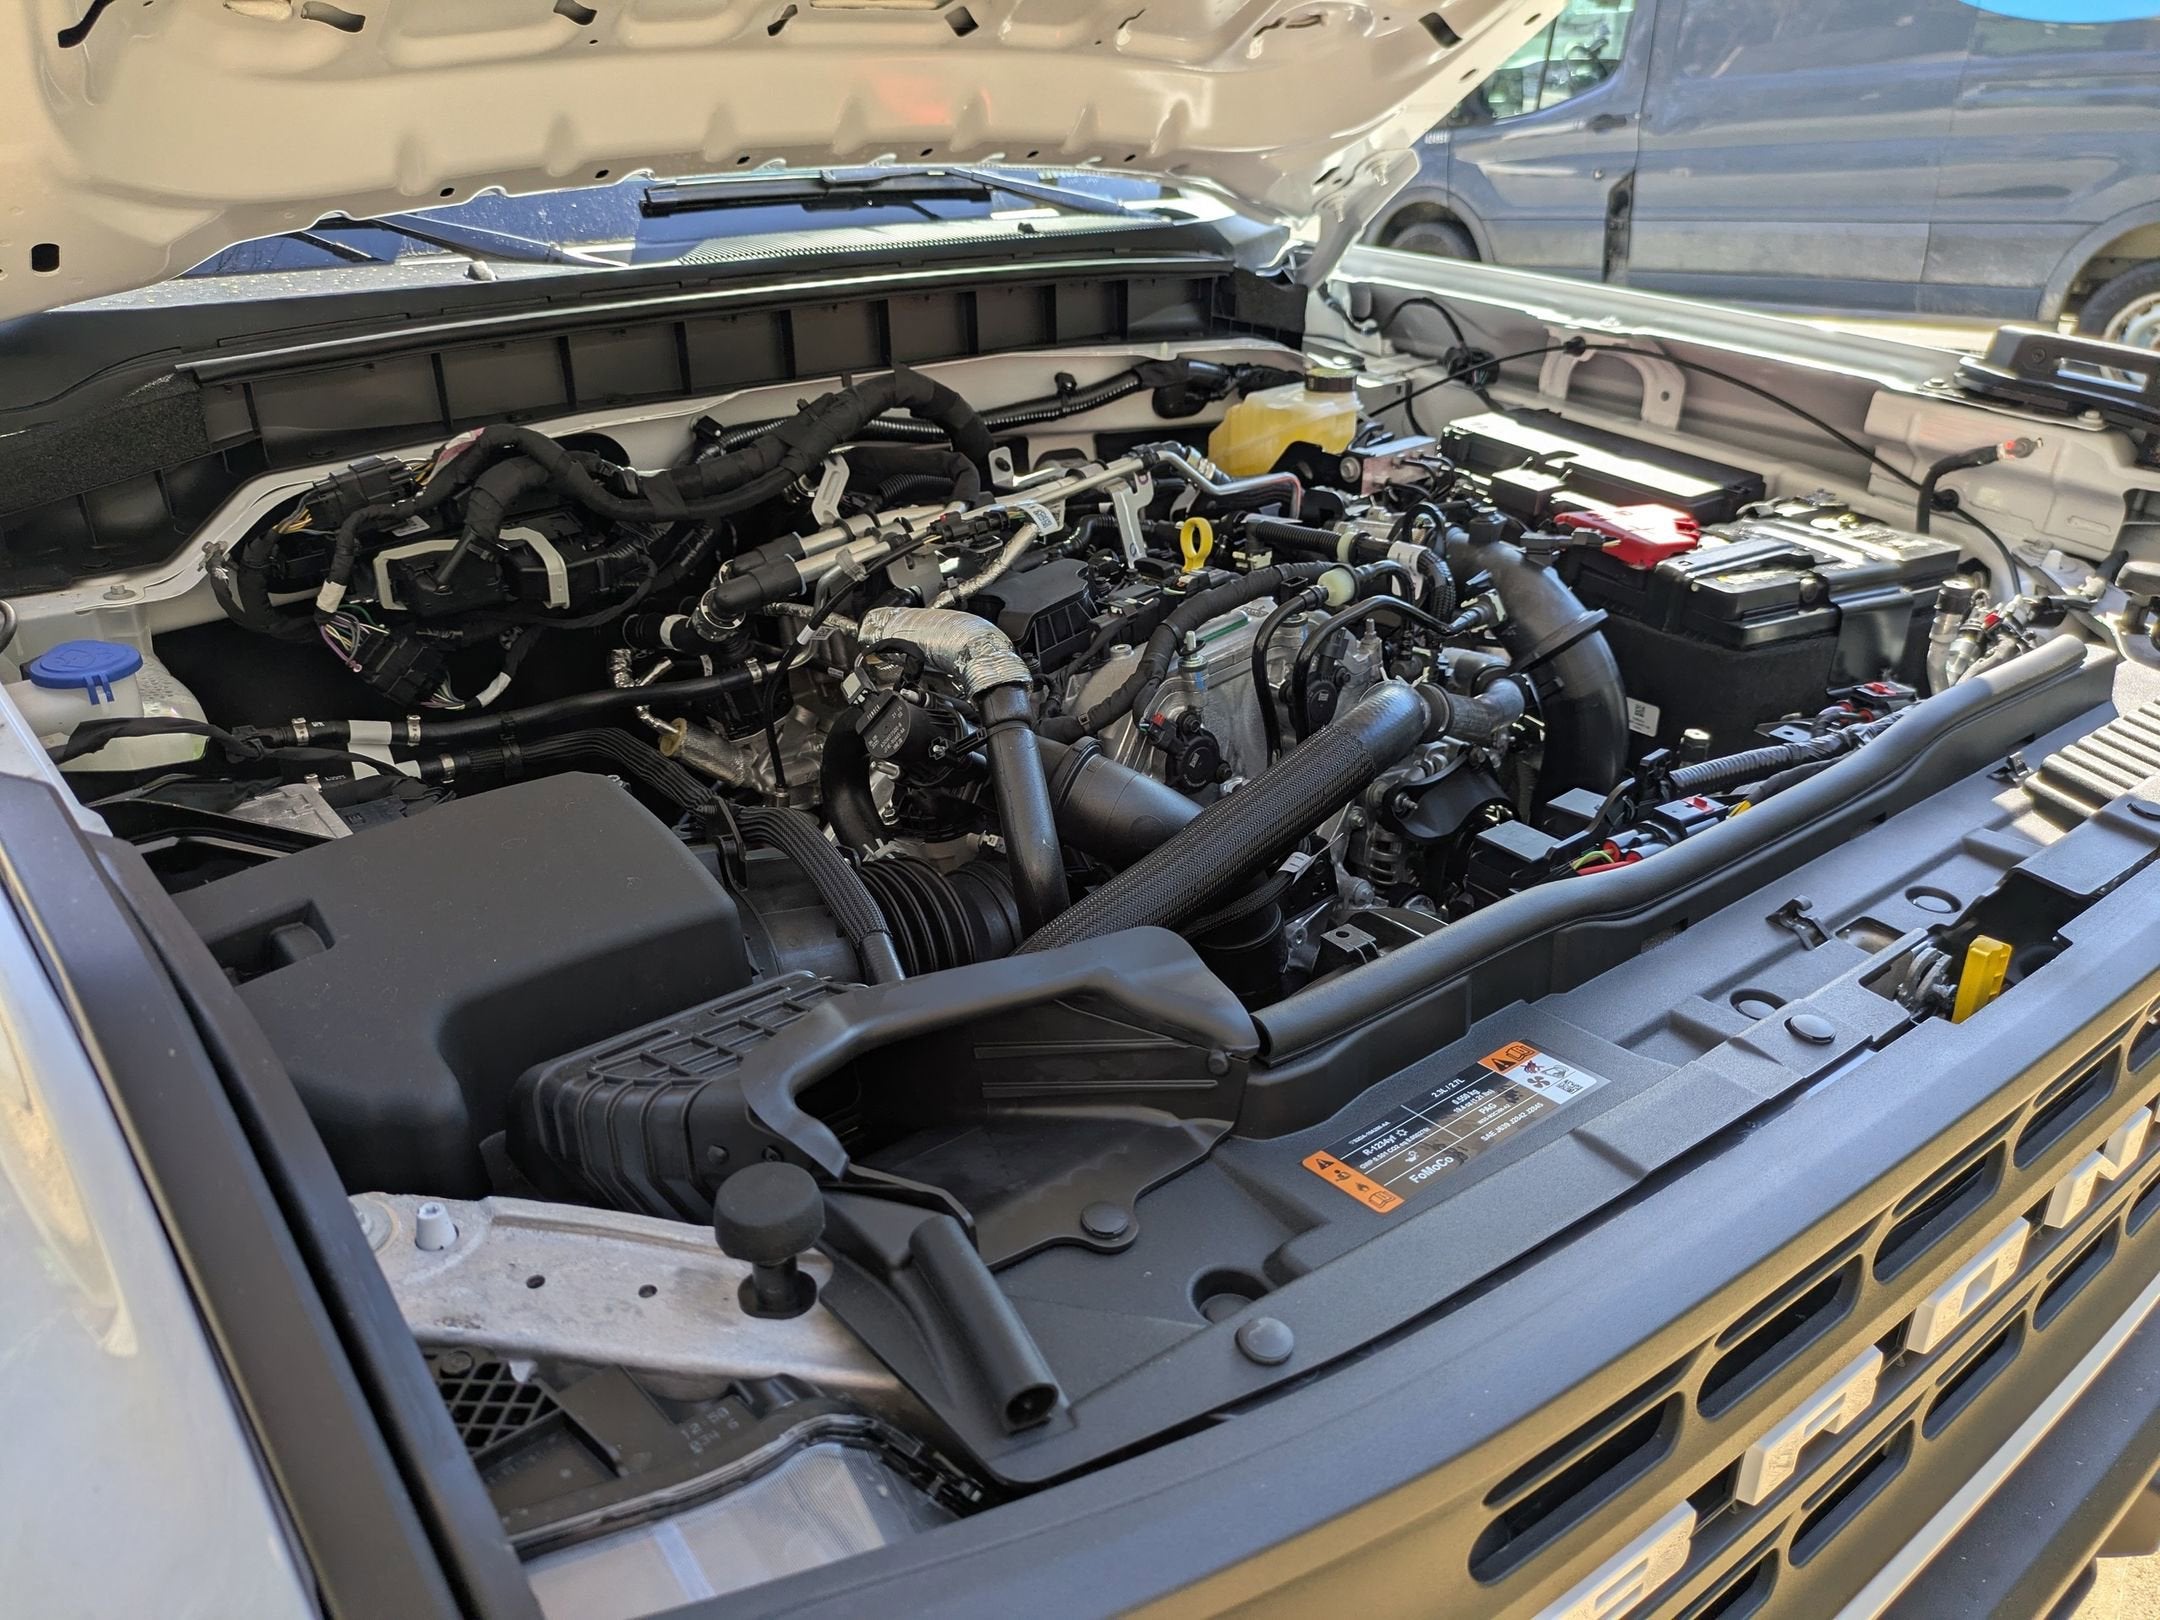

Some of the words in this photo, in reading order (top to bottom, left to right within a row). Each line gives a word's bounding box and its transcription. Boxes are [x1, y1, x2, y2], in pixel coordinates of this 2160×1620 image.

[1431, 1088, 1449, 1098] 2.3L
[1448, 1078, 1466, 1089] 2.7L
[1467, 1089, 1481, 1098] kg
[1478, 1103, 1497, 1115] PAG
[1480, 1130, 1497, 1141] SAE
[1362, 1134, 1397, 1156] R-1234yf
[1387, 1144, 1400, 1153] CO2
[1409, 1156, 1455, 1184] FoMoCo
